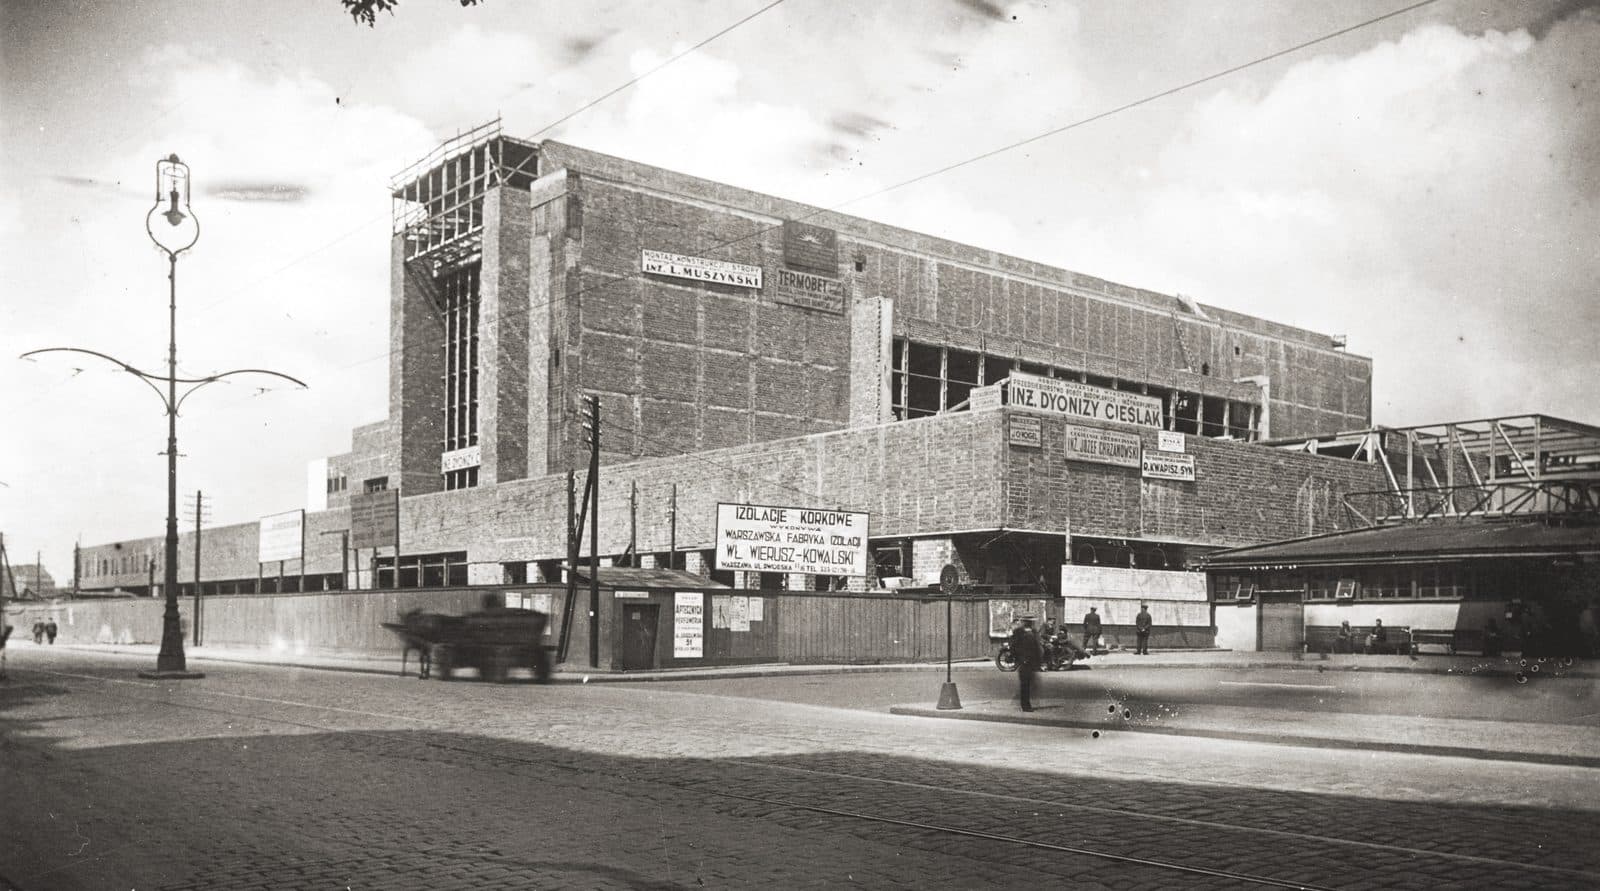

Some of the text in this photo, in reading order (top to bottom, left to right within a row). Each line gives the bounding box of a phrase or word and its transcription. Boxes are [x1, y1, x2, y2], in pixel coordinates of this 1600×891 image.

[779, 269, 827, 293] TERMOBET
[1012, 386, 1037, 408] INŻ.
[1041, 391, 1100, 418] DYONIZY
[736, 506, 852, 527] IZOLACJE KORKOWE
[725, 529, 781, 542] WARSZAWSKA
[787, 533, 825, 545] FABRYKA
